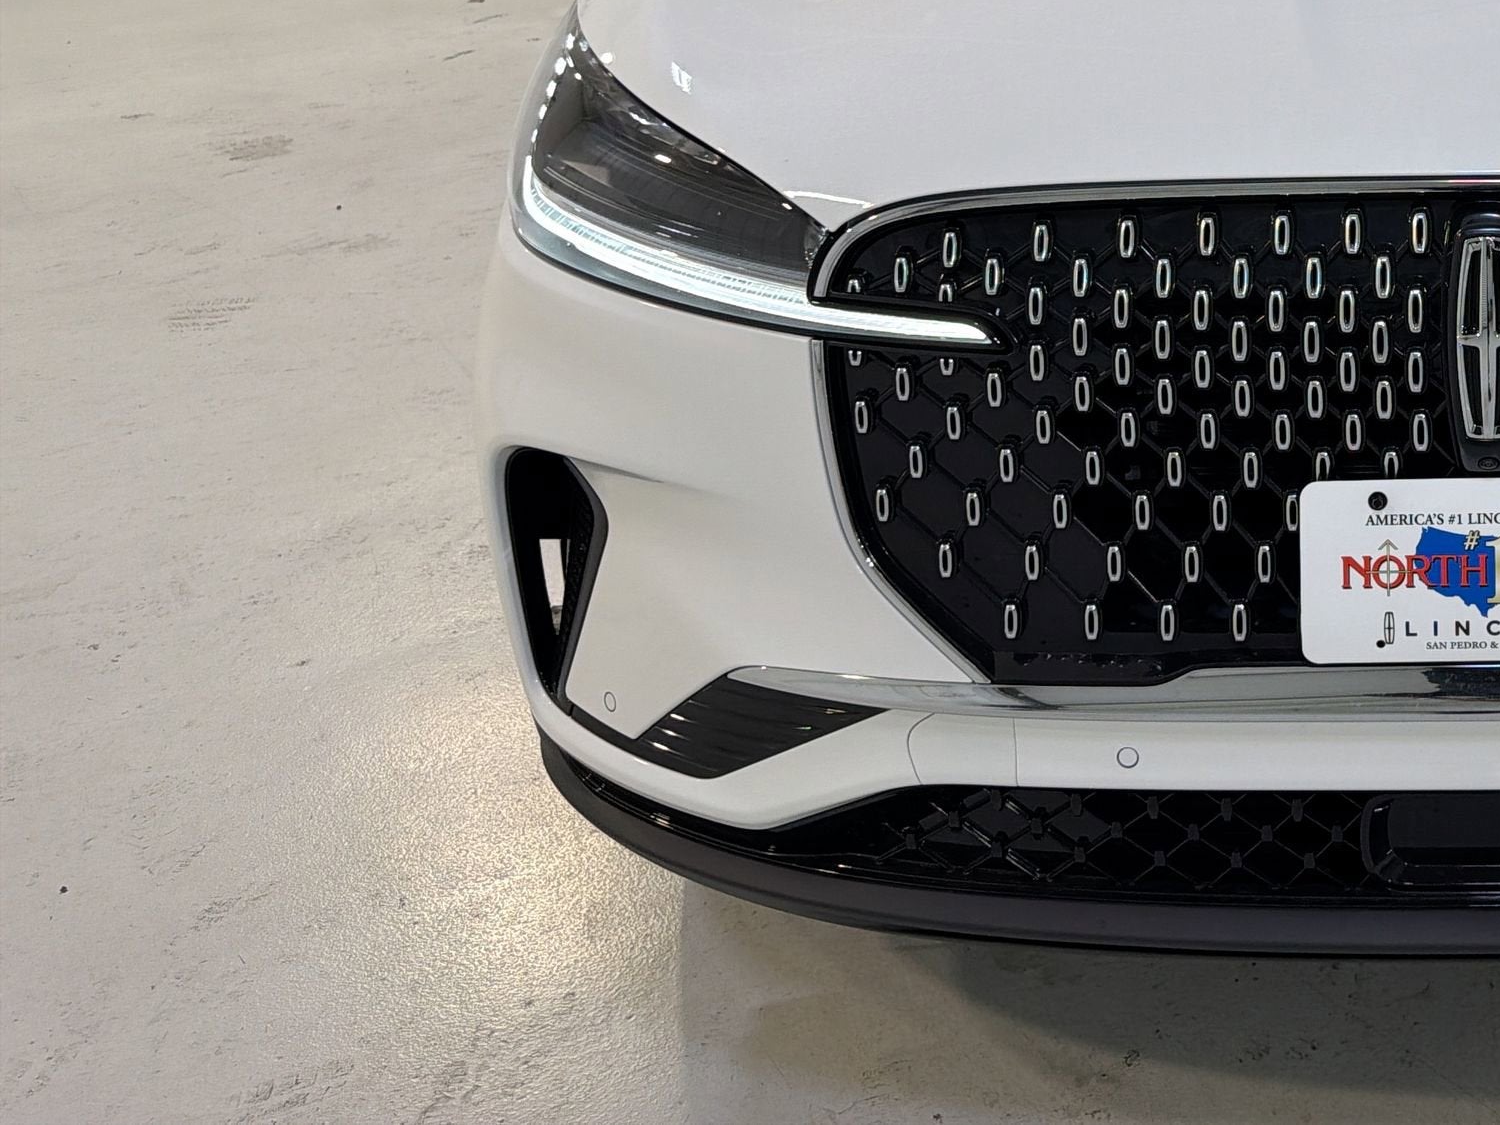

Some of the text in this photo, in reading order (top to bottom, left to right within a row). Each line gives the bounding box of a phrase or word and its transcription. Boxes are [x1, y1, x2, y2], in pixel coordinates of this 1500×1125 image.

[1448, 513, 1464, 525] #1
[1340, 552, 1490, 590] NORTH
[1426, 641, 1448, 650] SAN
[1450, 641, 1488, 650] PEDRO
[1490, 641, 1500, 650] &
